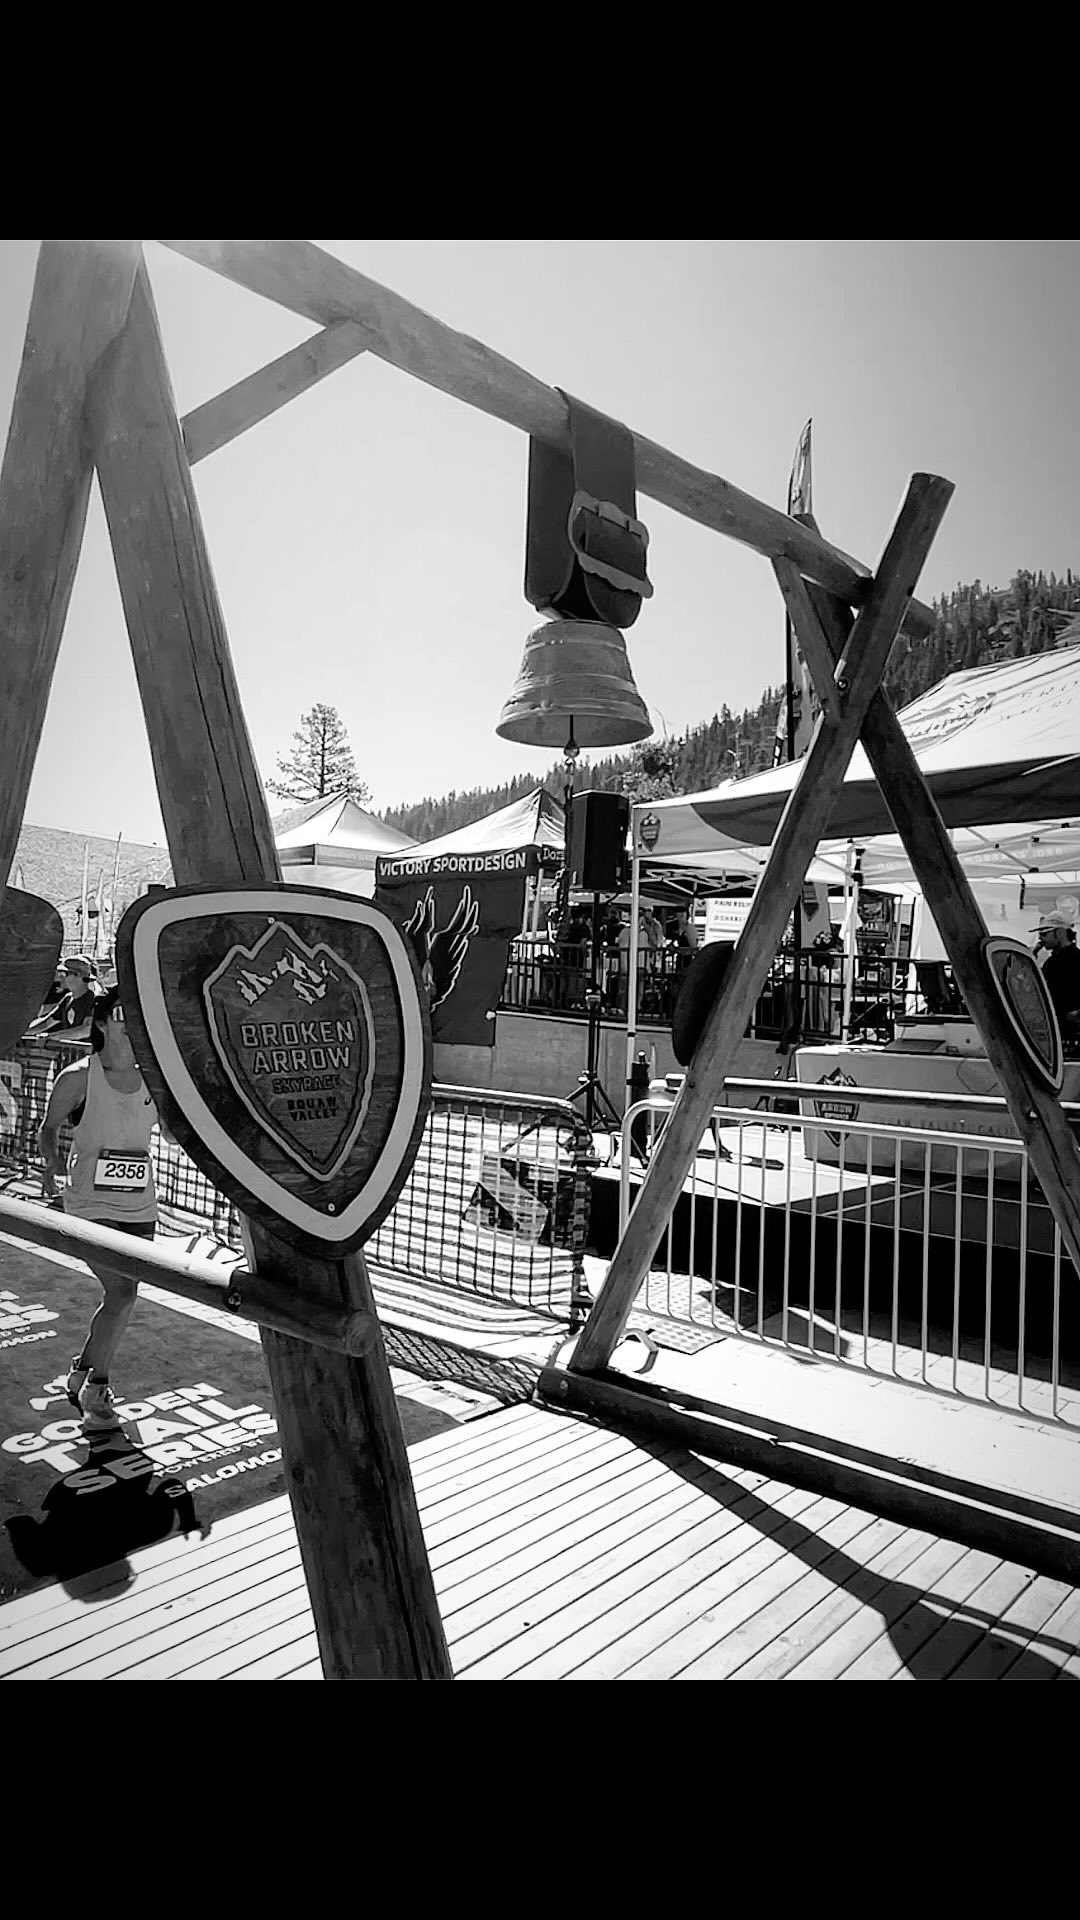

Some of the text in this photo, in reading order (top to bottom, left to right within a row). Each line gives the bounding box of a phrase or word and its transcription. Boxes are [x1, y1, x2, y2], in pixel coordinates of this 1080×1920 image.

[379, 852, 527, 876] VICTORY SPORTDESIGN
[241, 1020, 354, 1047] BROKEN
[253, 1046, 350, 1074] ARROW
[273, 1075, 340, 1094] SKYRACE
[287, 1096, 337, 1111] SQUAW
[290, 1108, 337, 1121] VALLEY
[104, 1162, 146, 1180] 2358
[1, 1382, 224, 1453] GODEN
[63, 1413, 279, 1496] SERIES
[164, 1447, 282, 1498] SALOMO
